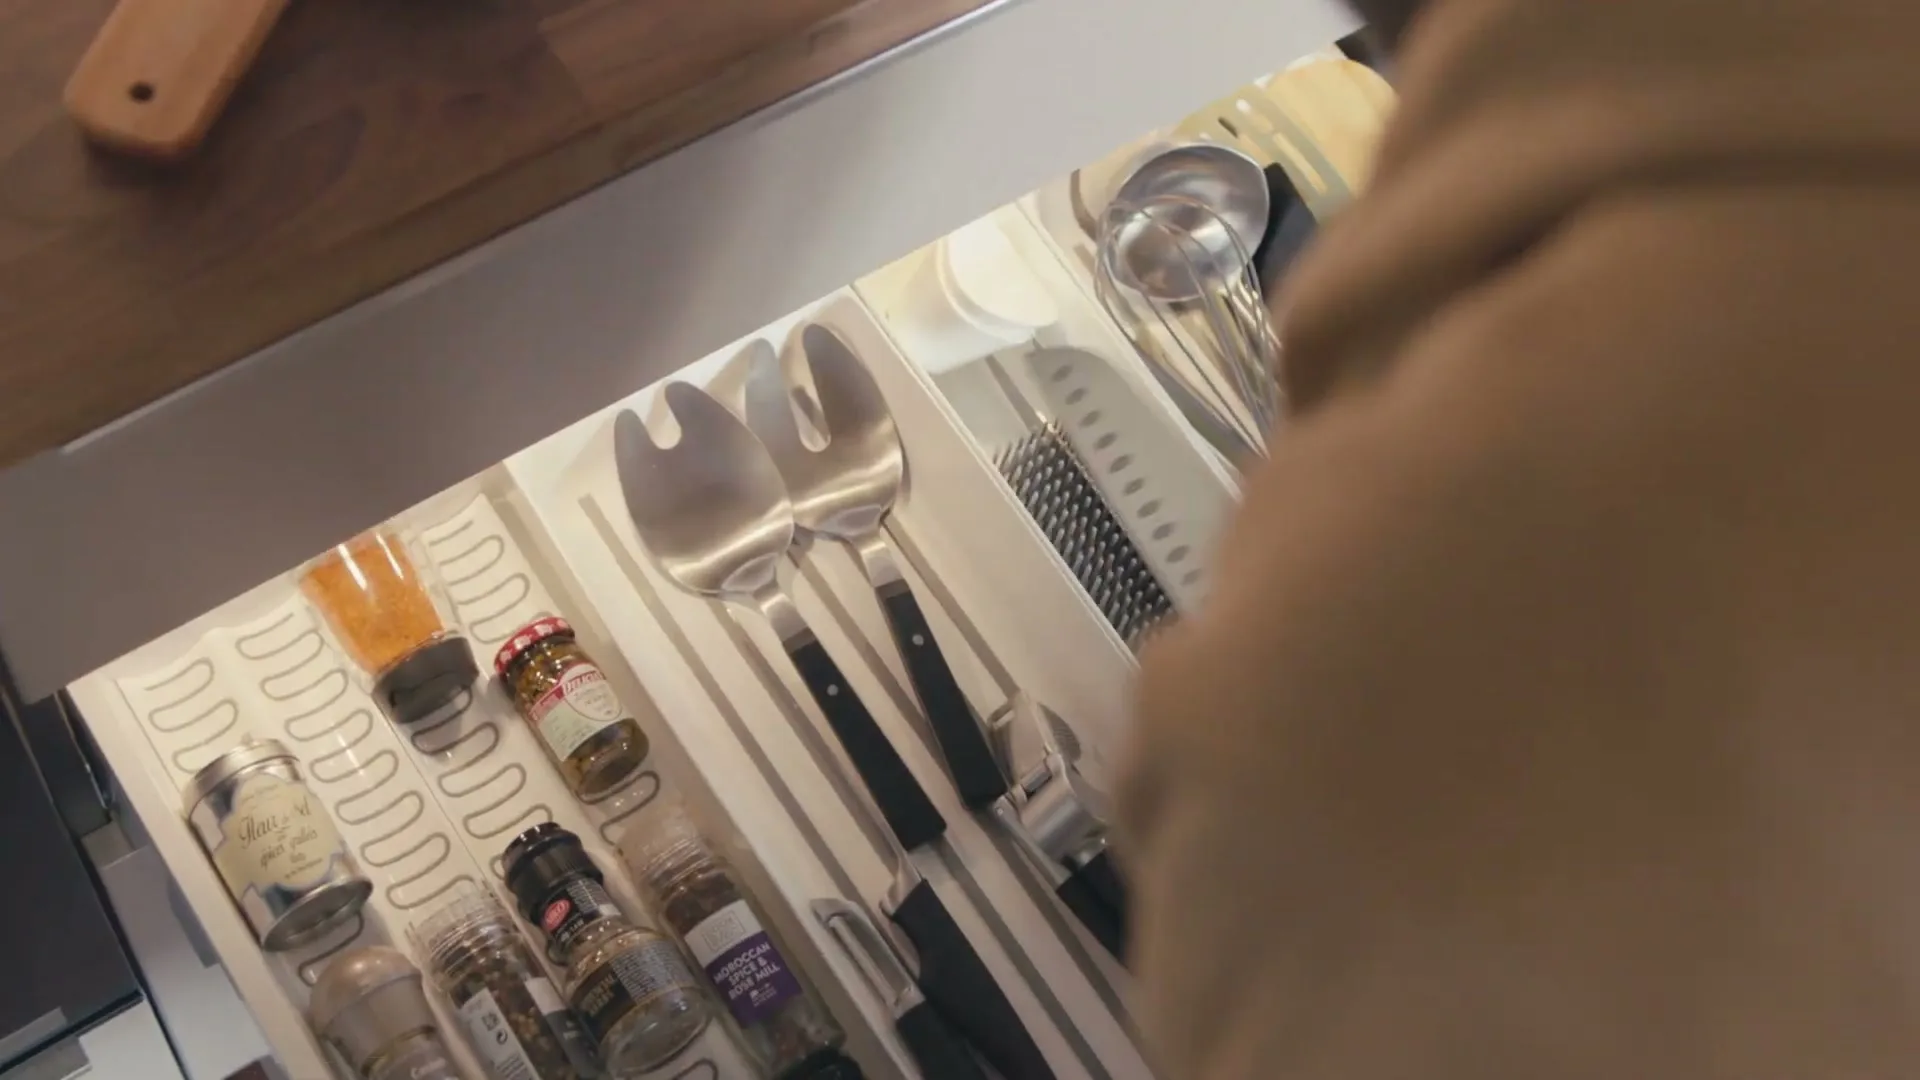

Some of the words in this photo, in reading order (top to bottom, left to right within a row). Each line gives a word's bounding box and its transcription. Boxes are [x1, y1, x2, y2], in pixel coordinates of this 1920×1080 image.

[713, 941, 771, 985] MOROCCAN
[728, 961, 758, 986] SPICE
[757, 956, 768, 967] &
[728, 978, 755, 1000] ROSE
[755, 963, 781, 982] MILL
